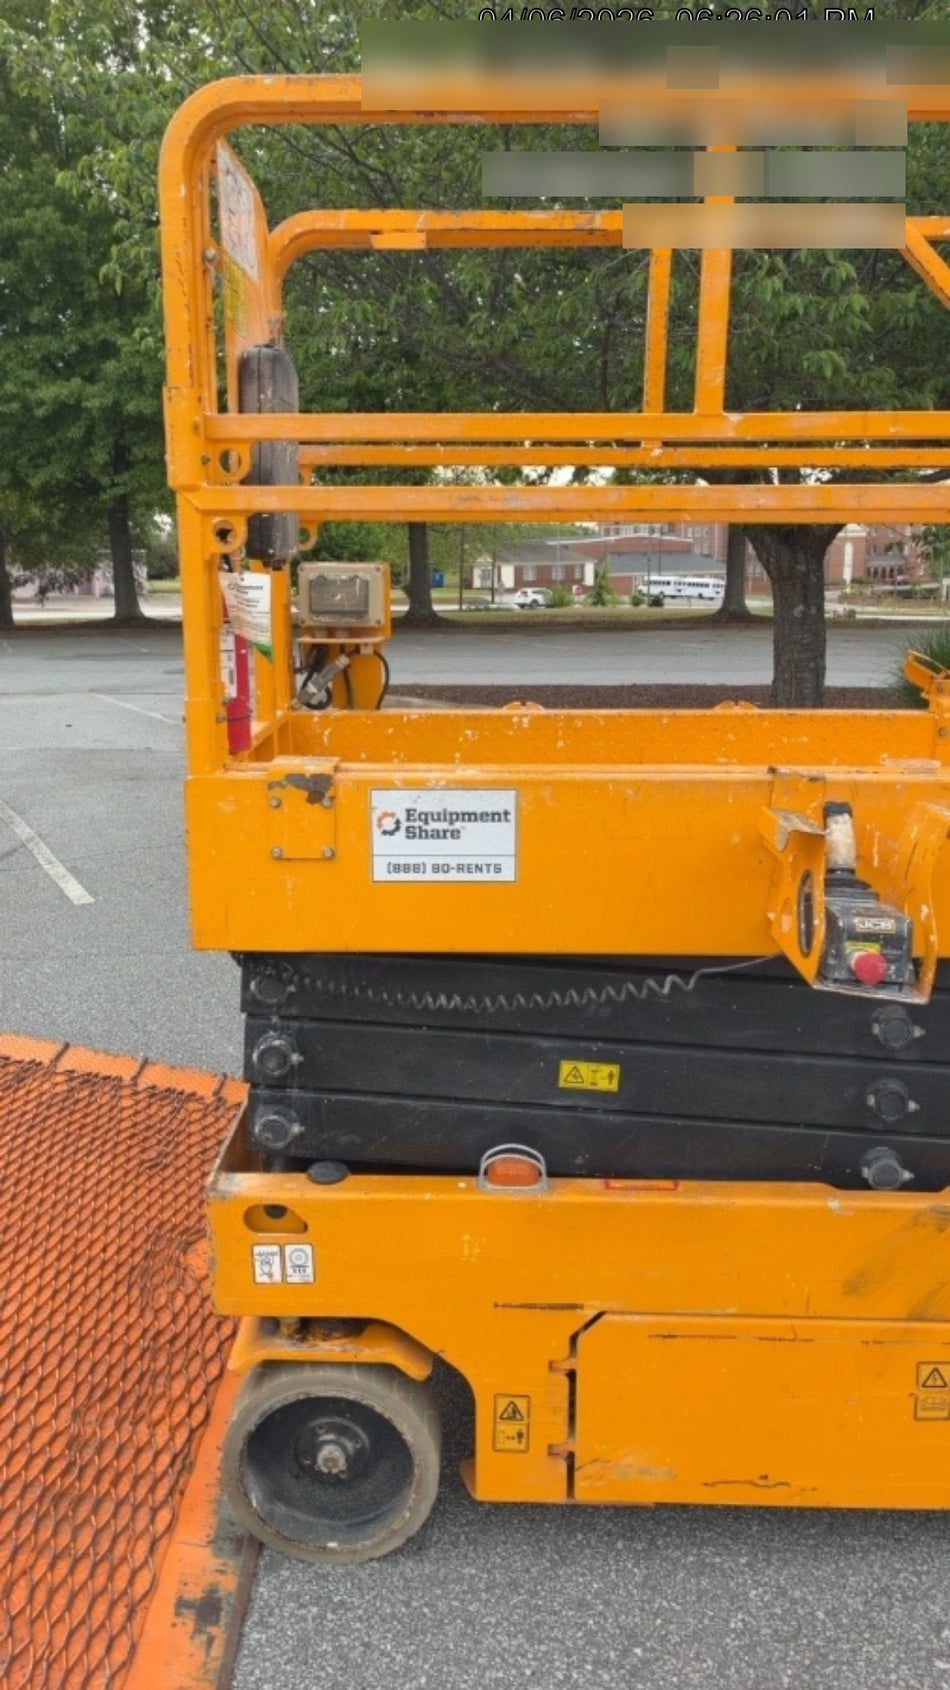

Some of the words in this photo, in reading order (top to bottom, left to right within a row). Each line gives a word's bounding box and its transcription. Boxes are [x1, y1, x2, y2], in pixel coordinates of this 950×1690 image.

[405, 808, 511, 826] Equipment
[405, 826, 462, 840] Share
[386, 861, 427, 875] (888)
[859, 919, 892, 930] JCB
